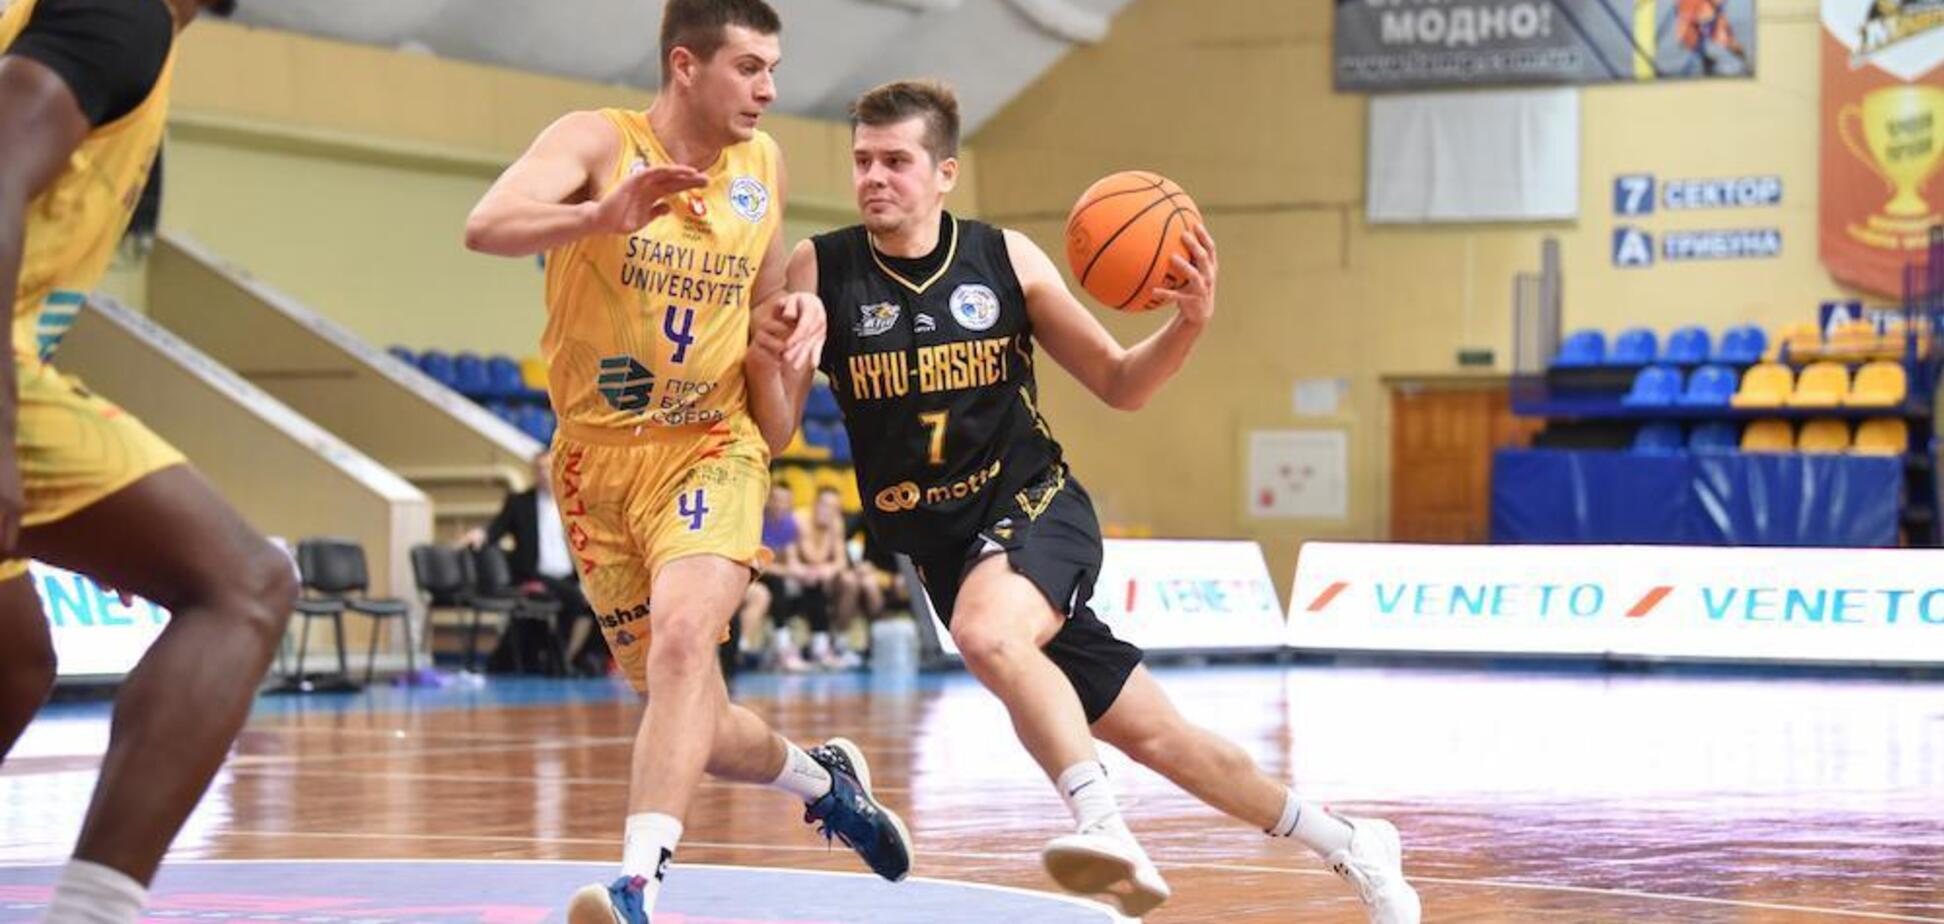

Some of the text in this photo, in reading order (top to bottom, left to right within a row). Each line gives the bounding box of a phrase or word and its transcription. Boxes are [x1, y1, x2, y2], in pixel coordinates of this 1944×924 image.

[1380, 4, 1551, 46] МОДНО!
[1620, 176, 1780, 214] 7 СЕКТОР
[625, 236, 695, 271] STARYI
[663, 304, 695, 365] 4
[665, 379, 719, 396] ПРО
[919, 411, 949, 463] 7
[678, 488, 710, 530] 4
[1375, 583, 1606, 616] VENETO
